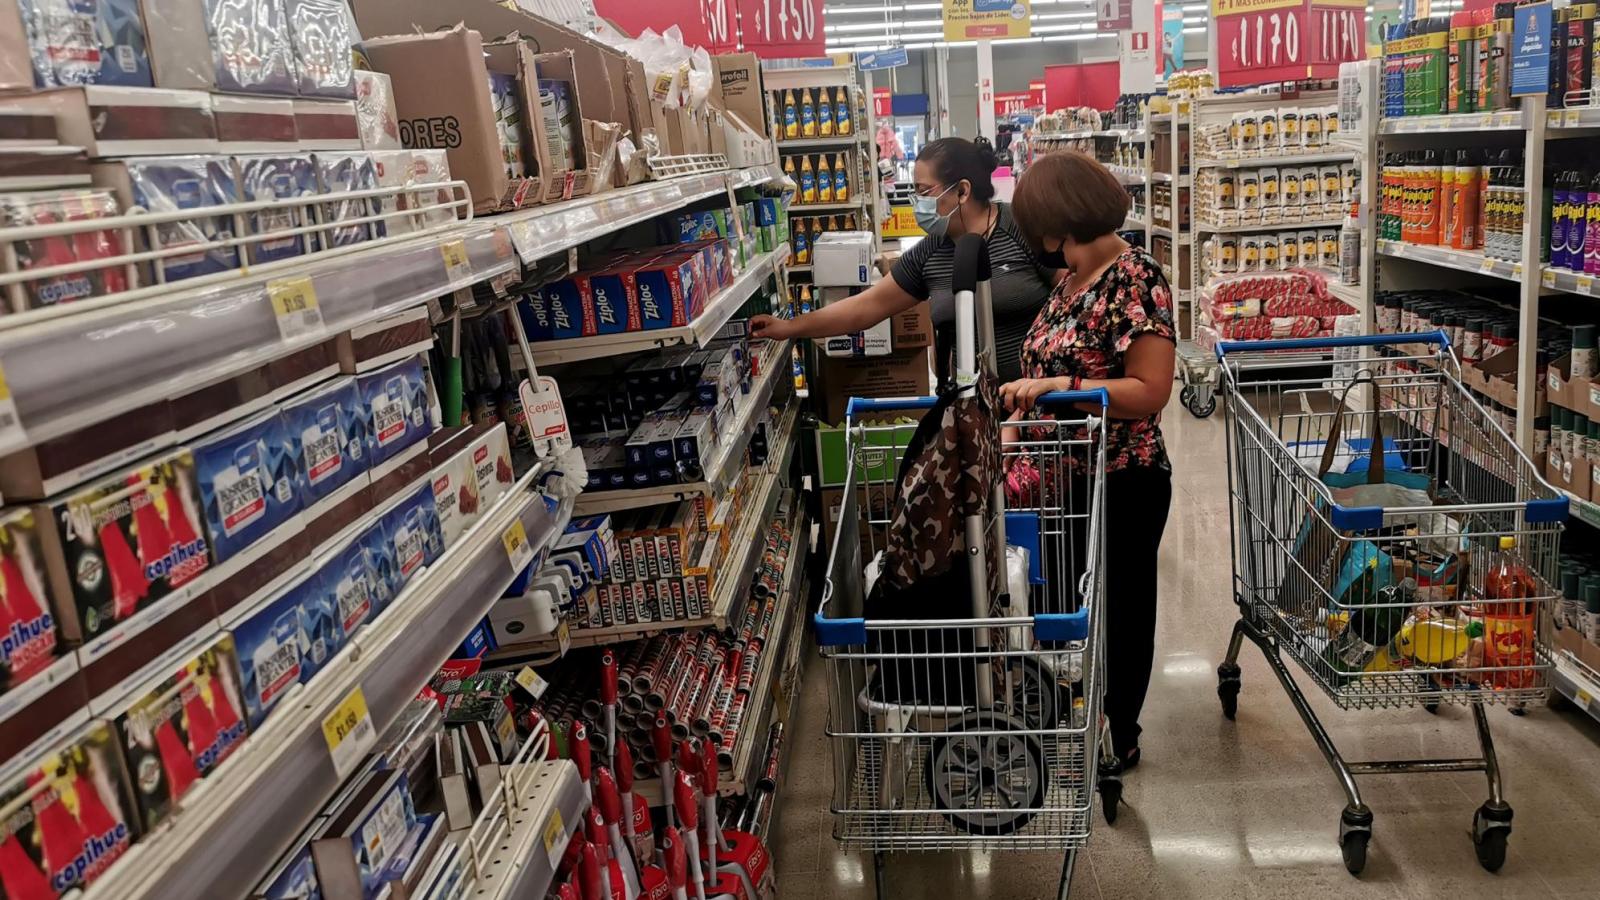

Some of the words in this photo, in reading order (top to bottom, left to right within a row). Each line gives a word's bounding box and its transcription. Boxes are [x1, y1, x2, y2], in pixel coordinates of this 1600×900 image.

[528, 292, 549, 327] Ziploc
[550, 294, 570, 328] Ziploc
[596, 289, 616, 323] Ziploc
[640, 284, 660, 319] Ziploc
[529, 400, 560, 415] Cepillo
[146, 537, 206, 581] copihue
[195, 720, 246, 769] copihue
[53, 822, 127, 890] copihue
[749, 850, 762, 868] Fibro
[651, 884, 668, 900] Fibro
